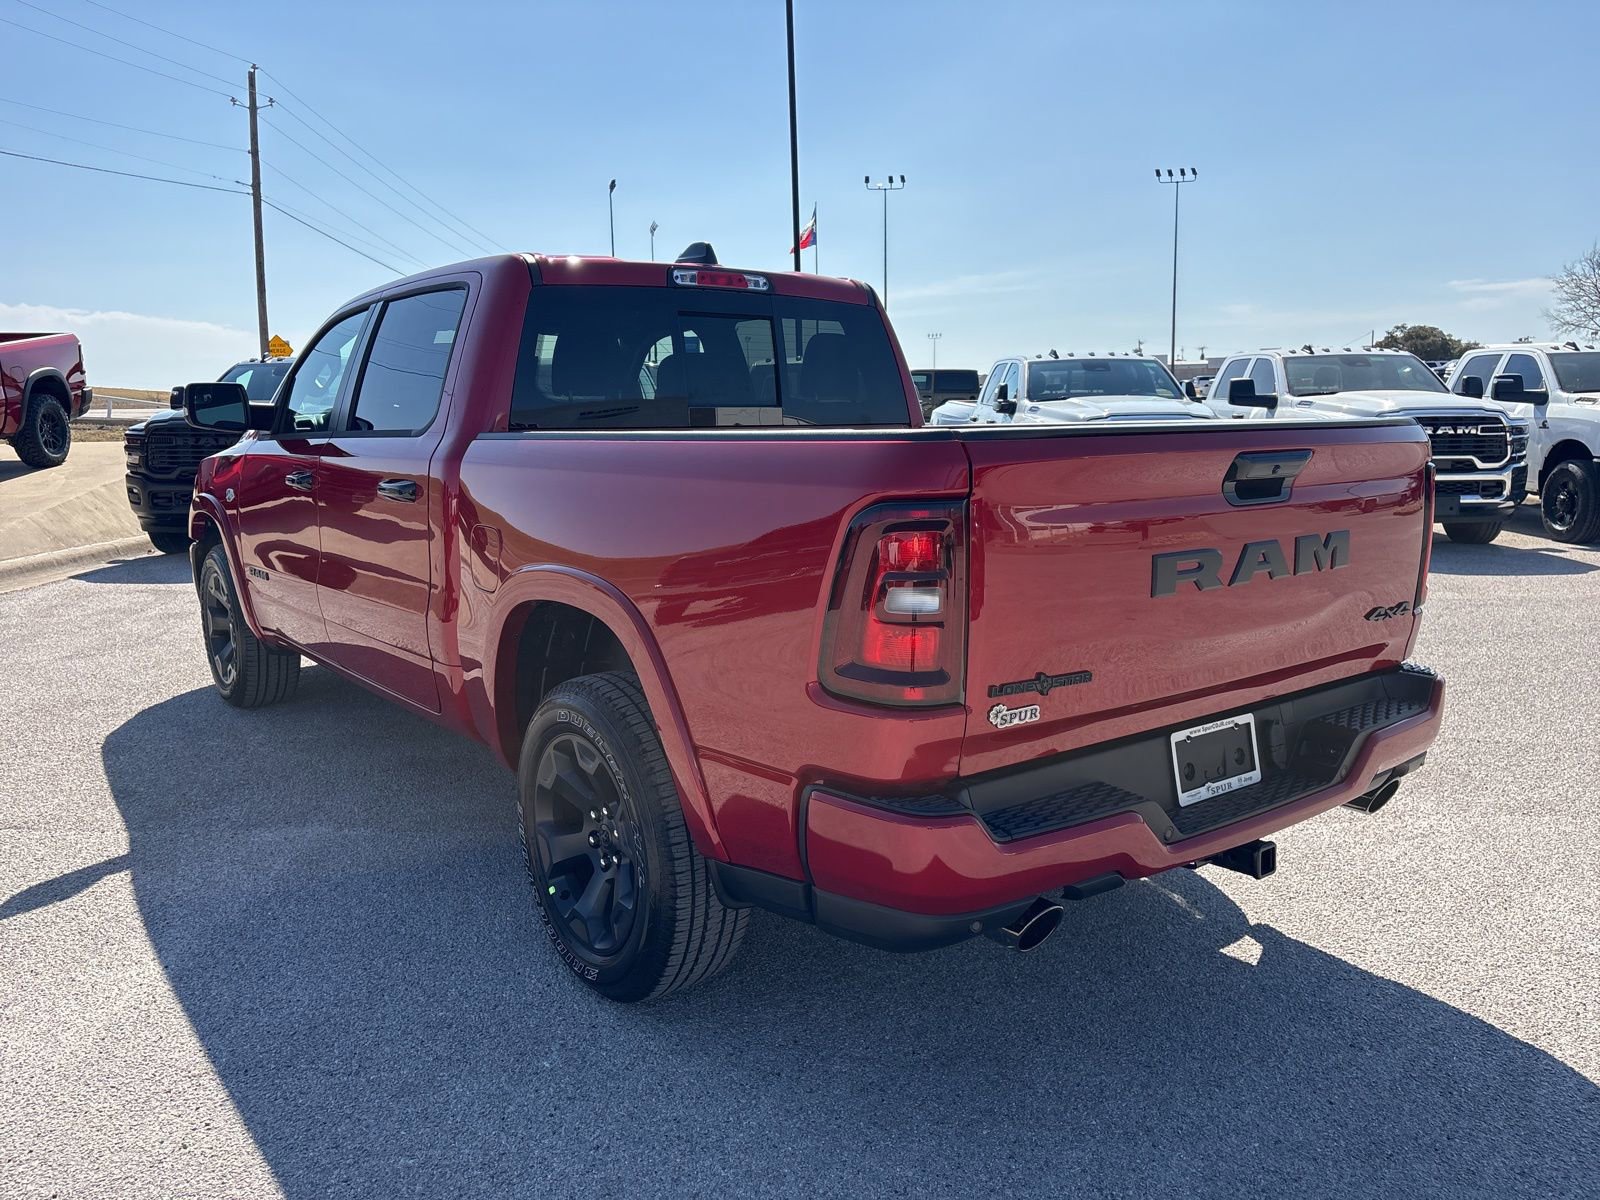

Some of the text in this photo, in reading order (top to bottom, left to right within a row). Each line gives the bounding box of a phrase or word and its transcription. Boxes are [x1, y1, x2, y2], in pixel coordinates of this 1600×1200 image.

[248, 566, 270, 581] RAM
[1151, 529, 1351, 599] RAM
[987, 670, 1092, 698] LONE STAR
[999, 707, 1039, 726] SPUR
[556, 709, 631, 801] DUELER
[1210, 782, 1233, 795] SPUR
